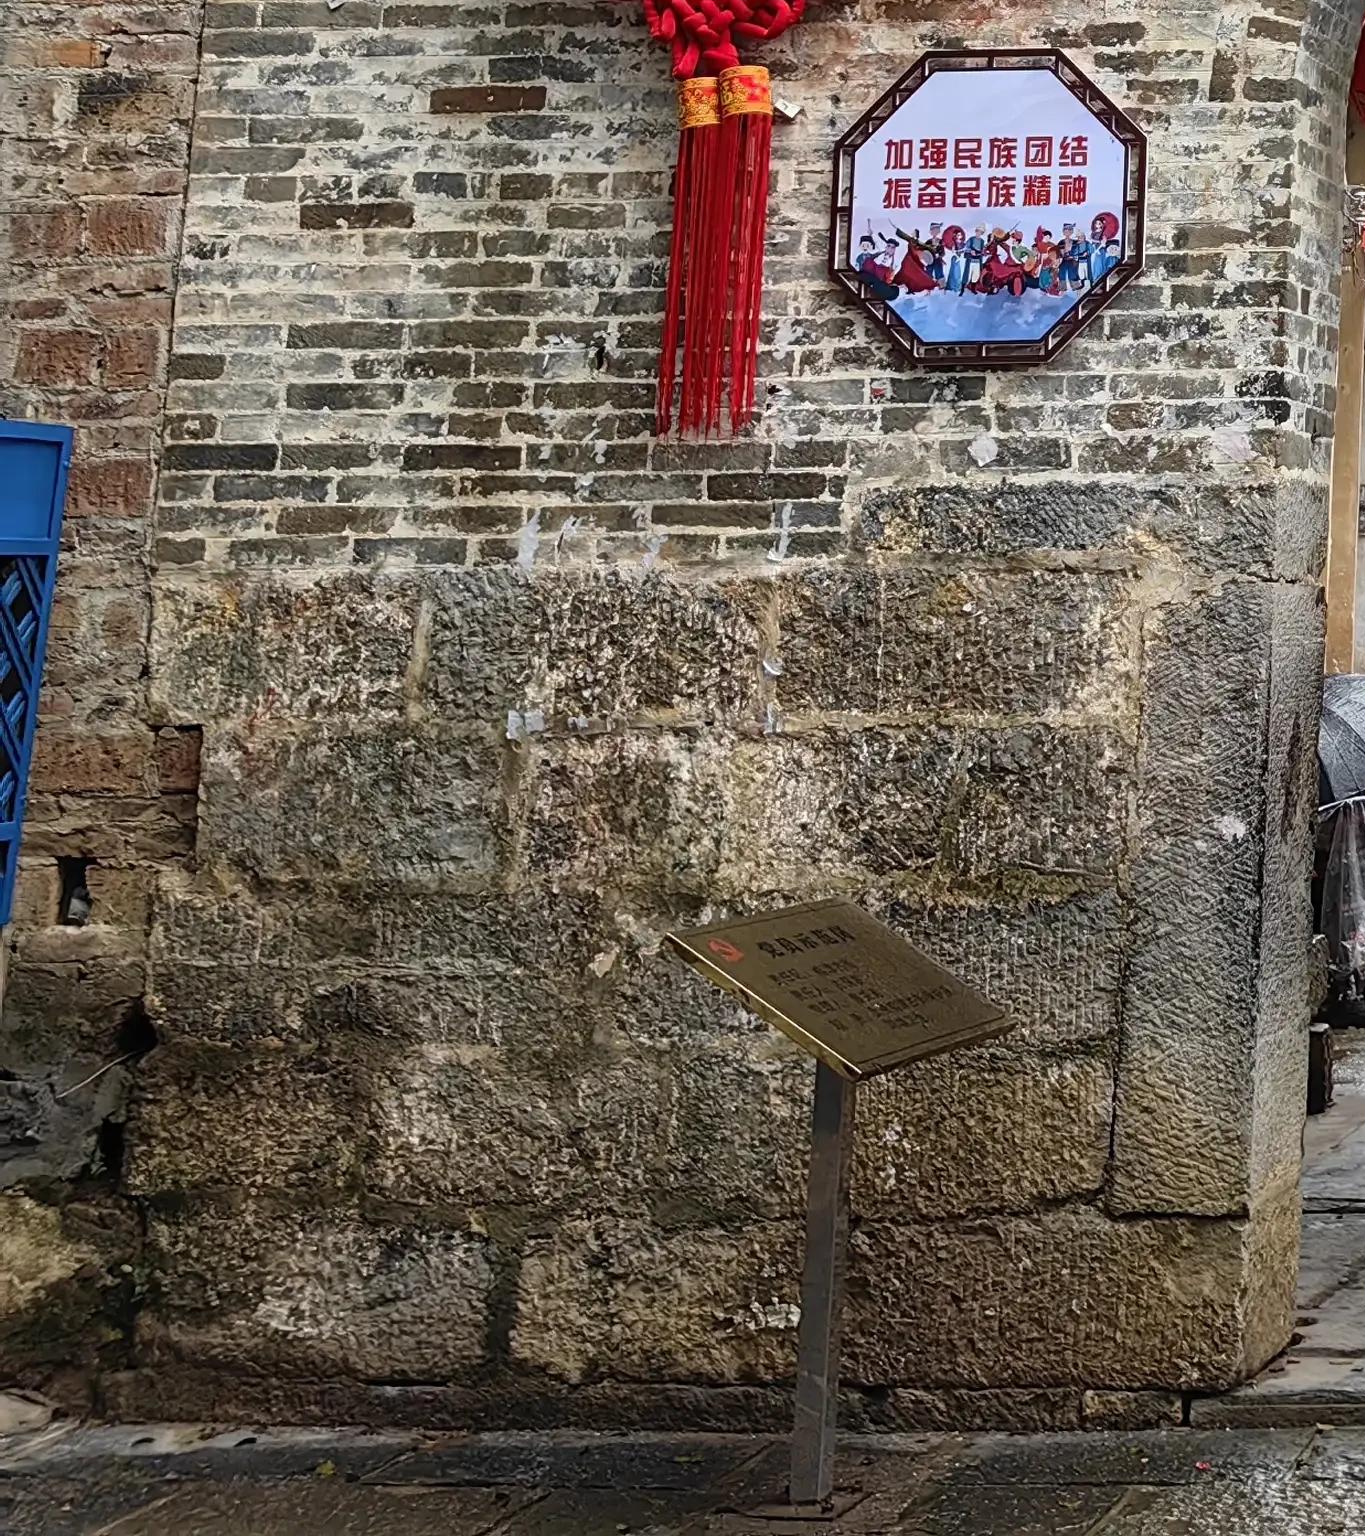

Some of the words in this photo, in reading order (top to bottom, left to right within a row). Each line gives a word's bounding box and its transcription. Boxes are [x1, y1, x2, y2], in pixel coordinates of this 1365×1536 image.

[884, 135, 1089, 170] 加强民族团结
[883, 174, 1088, 209] 振奋民族精神
